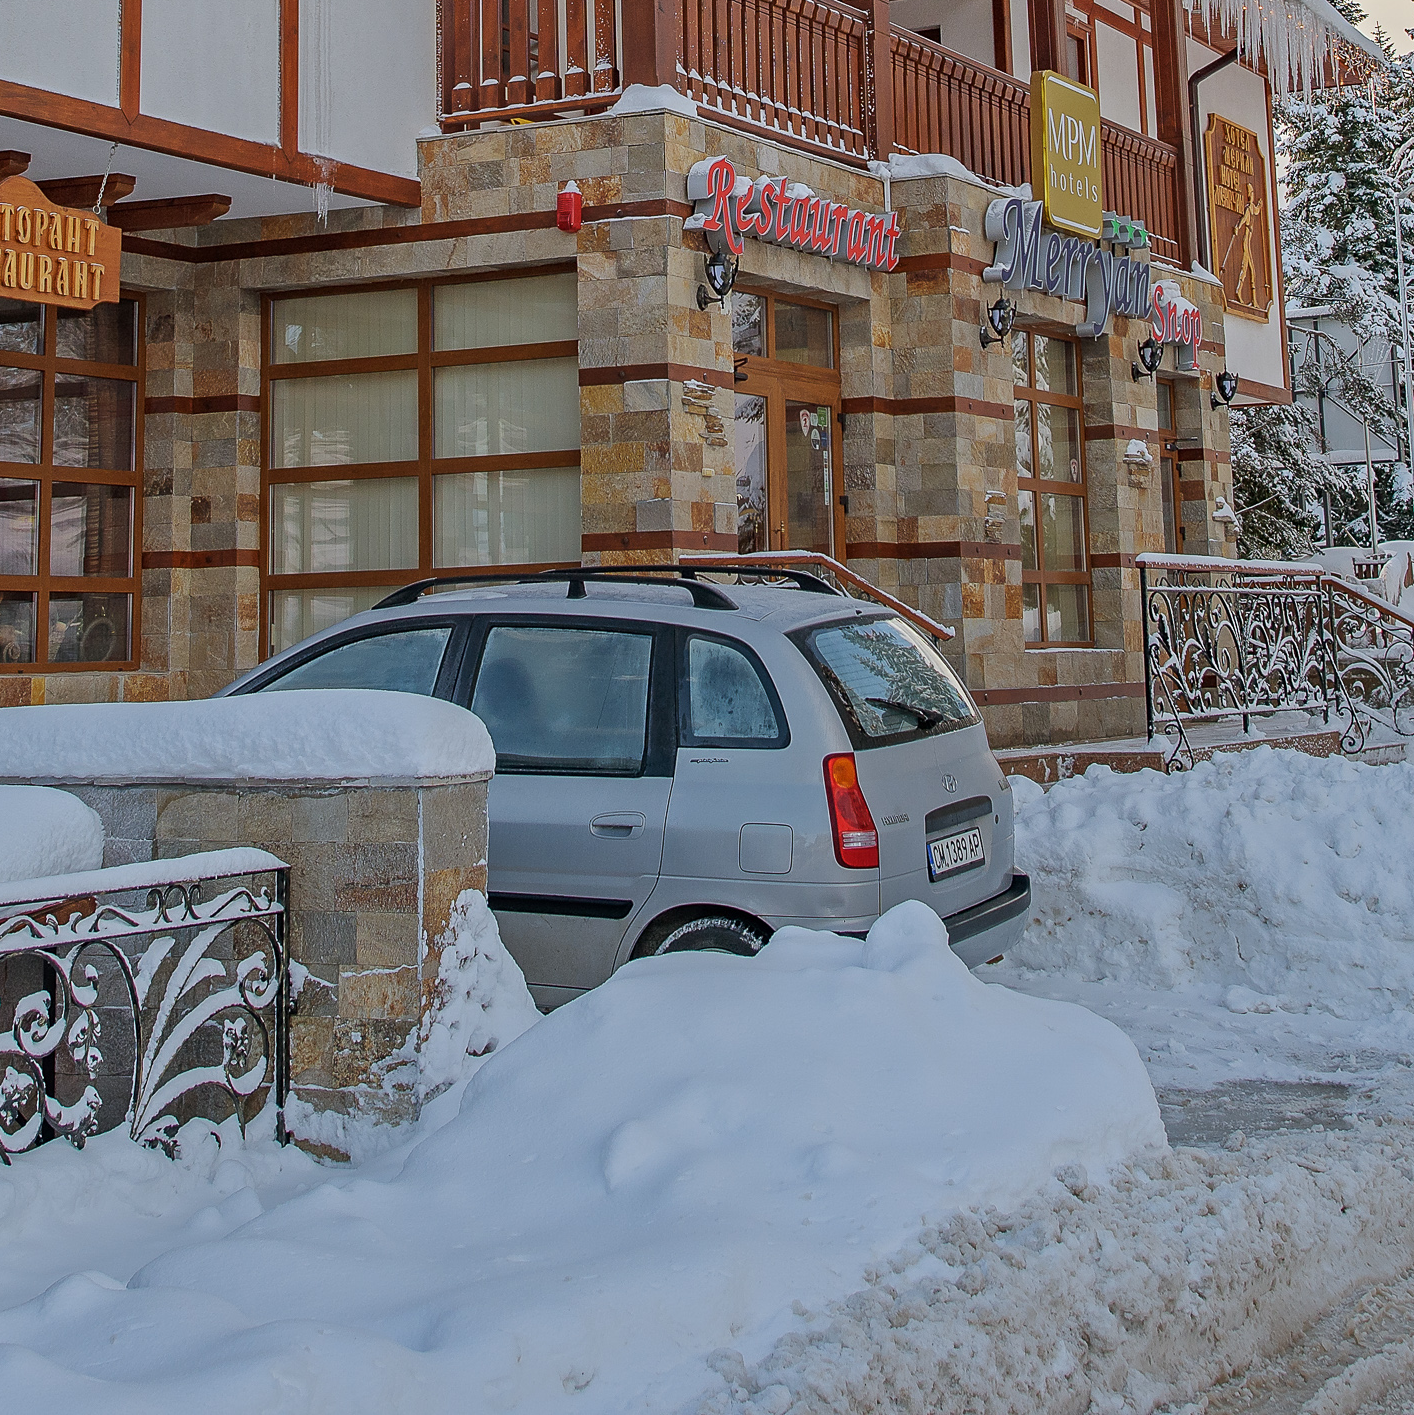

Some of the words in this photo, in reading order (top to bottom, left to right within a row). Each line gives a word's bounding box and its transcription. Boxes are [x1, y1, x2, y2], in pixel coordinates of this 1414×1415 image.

[1048, 107, 1097, 169] MPM
[1223, 123, 1250, 152] ХОТЕЛ
[702, 156, 902, 272] Restaurant
[1050, 163, 1099, 203] hotels
[1001, 198, 1153, 335] Merryan
